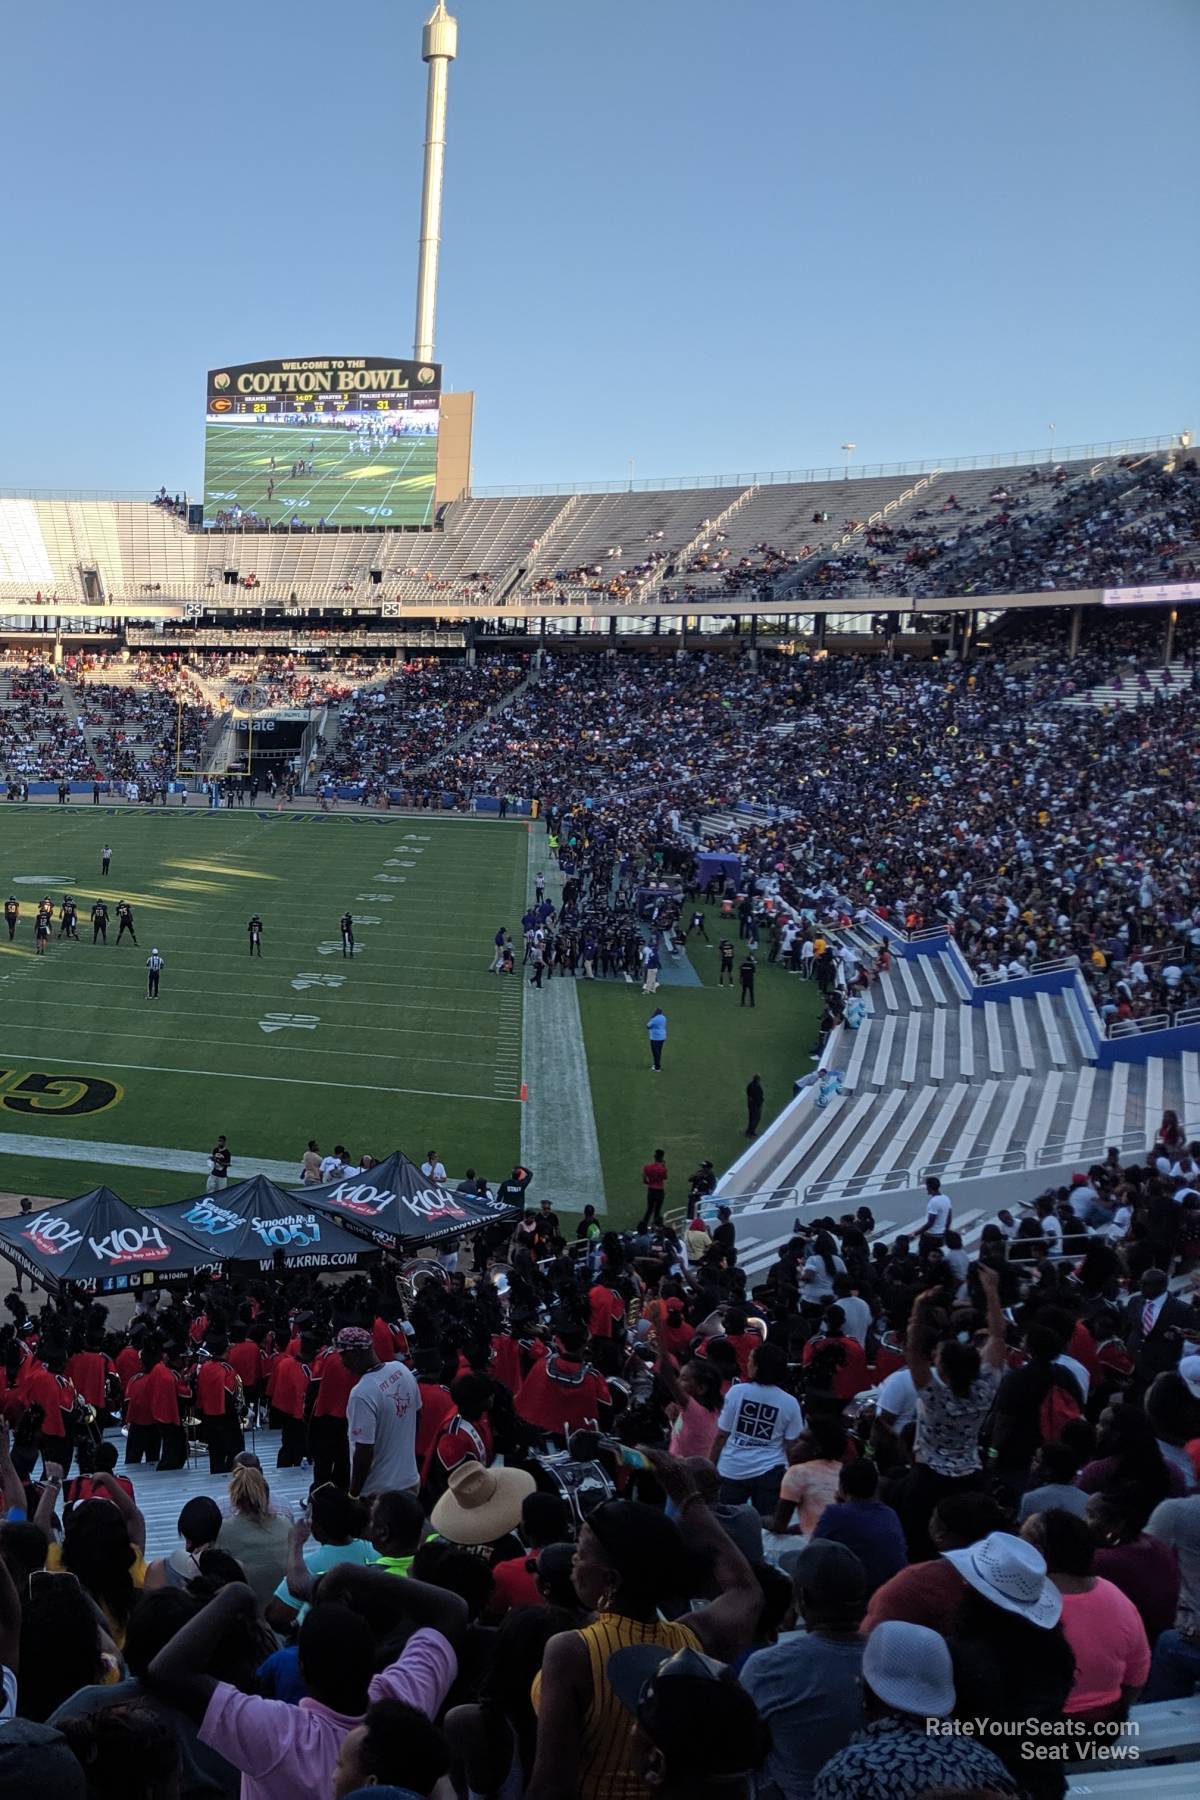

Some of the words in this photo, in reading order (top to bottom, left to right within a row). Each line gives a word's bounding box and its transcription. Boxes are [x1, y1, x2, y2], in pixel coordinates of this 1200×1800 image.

[282, 361, 329, 370] WELCOME
[332, 360, 345, 369] TO
[347, 359, 366, 368] THE
[237, 371, 334, 394] COTTON
[337, 369, 409, 391] BOWL
[253, 403, 267, 412] 23
[376, 400, 389, 410] 31
[187, 604, 200, 615] 25
[342, 608, 352, 616] 23
[384, 604, 398, 615] 25
[254, 811, 400, 825] VIEW
[328, 1183, 397, 1211] K104
[402, 1188, 460, 1216] K104
[25, 1211, 84, 1251] K104
[251, 1215, 295, 1231] Smooth
[88, 1226, 167, 1259] K104
[257, 1223, 321, 1246] 105.7
[260, 1253, 358, 1271] WW.KRNB.COM
